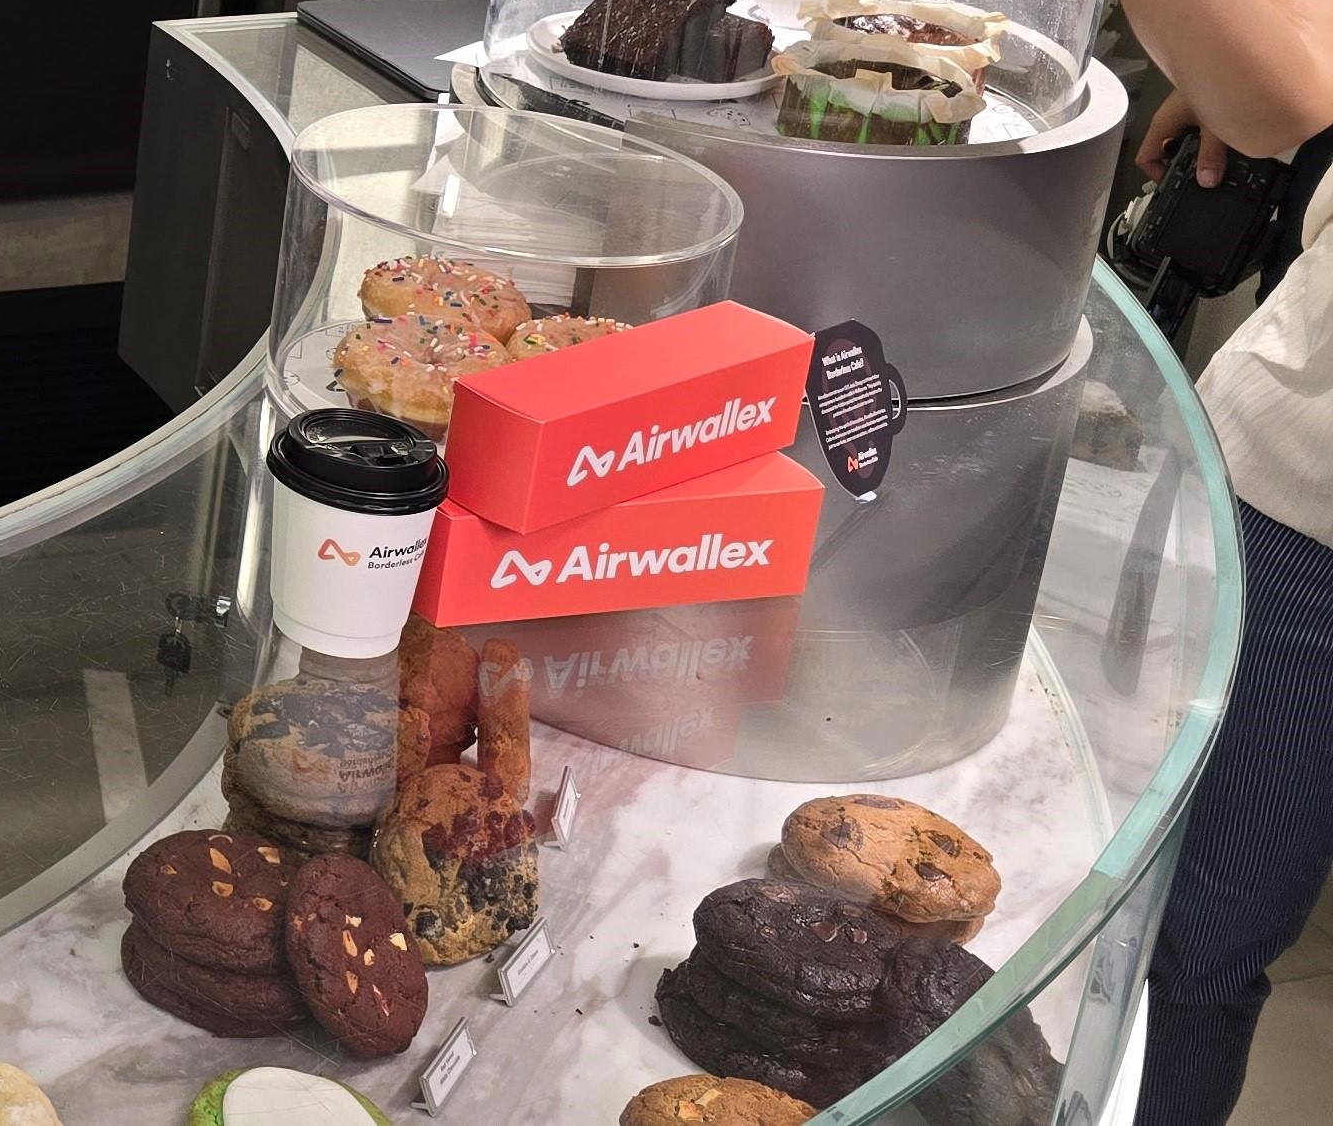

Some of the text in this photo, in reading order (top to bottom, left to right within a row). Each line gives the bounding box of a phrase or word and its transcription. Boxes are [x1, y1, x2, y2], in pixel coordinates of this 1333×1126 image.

[616, 396, 776, 472] Airwallex
[367, 556, 413, 569] Borderless
[556, 533, 774, 583] Airwallex
